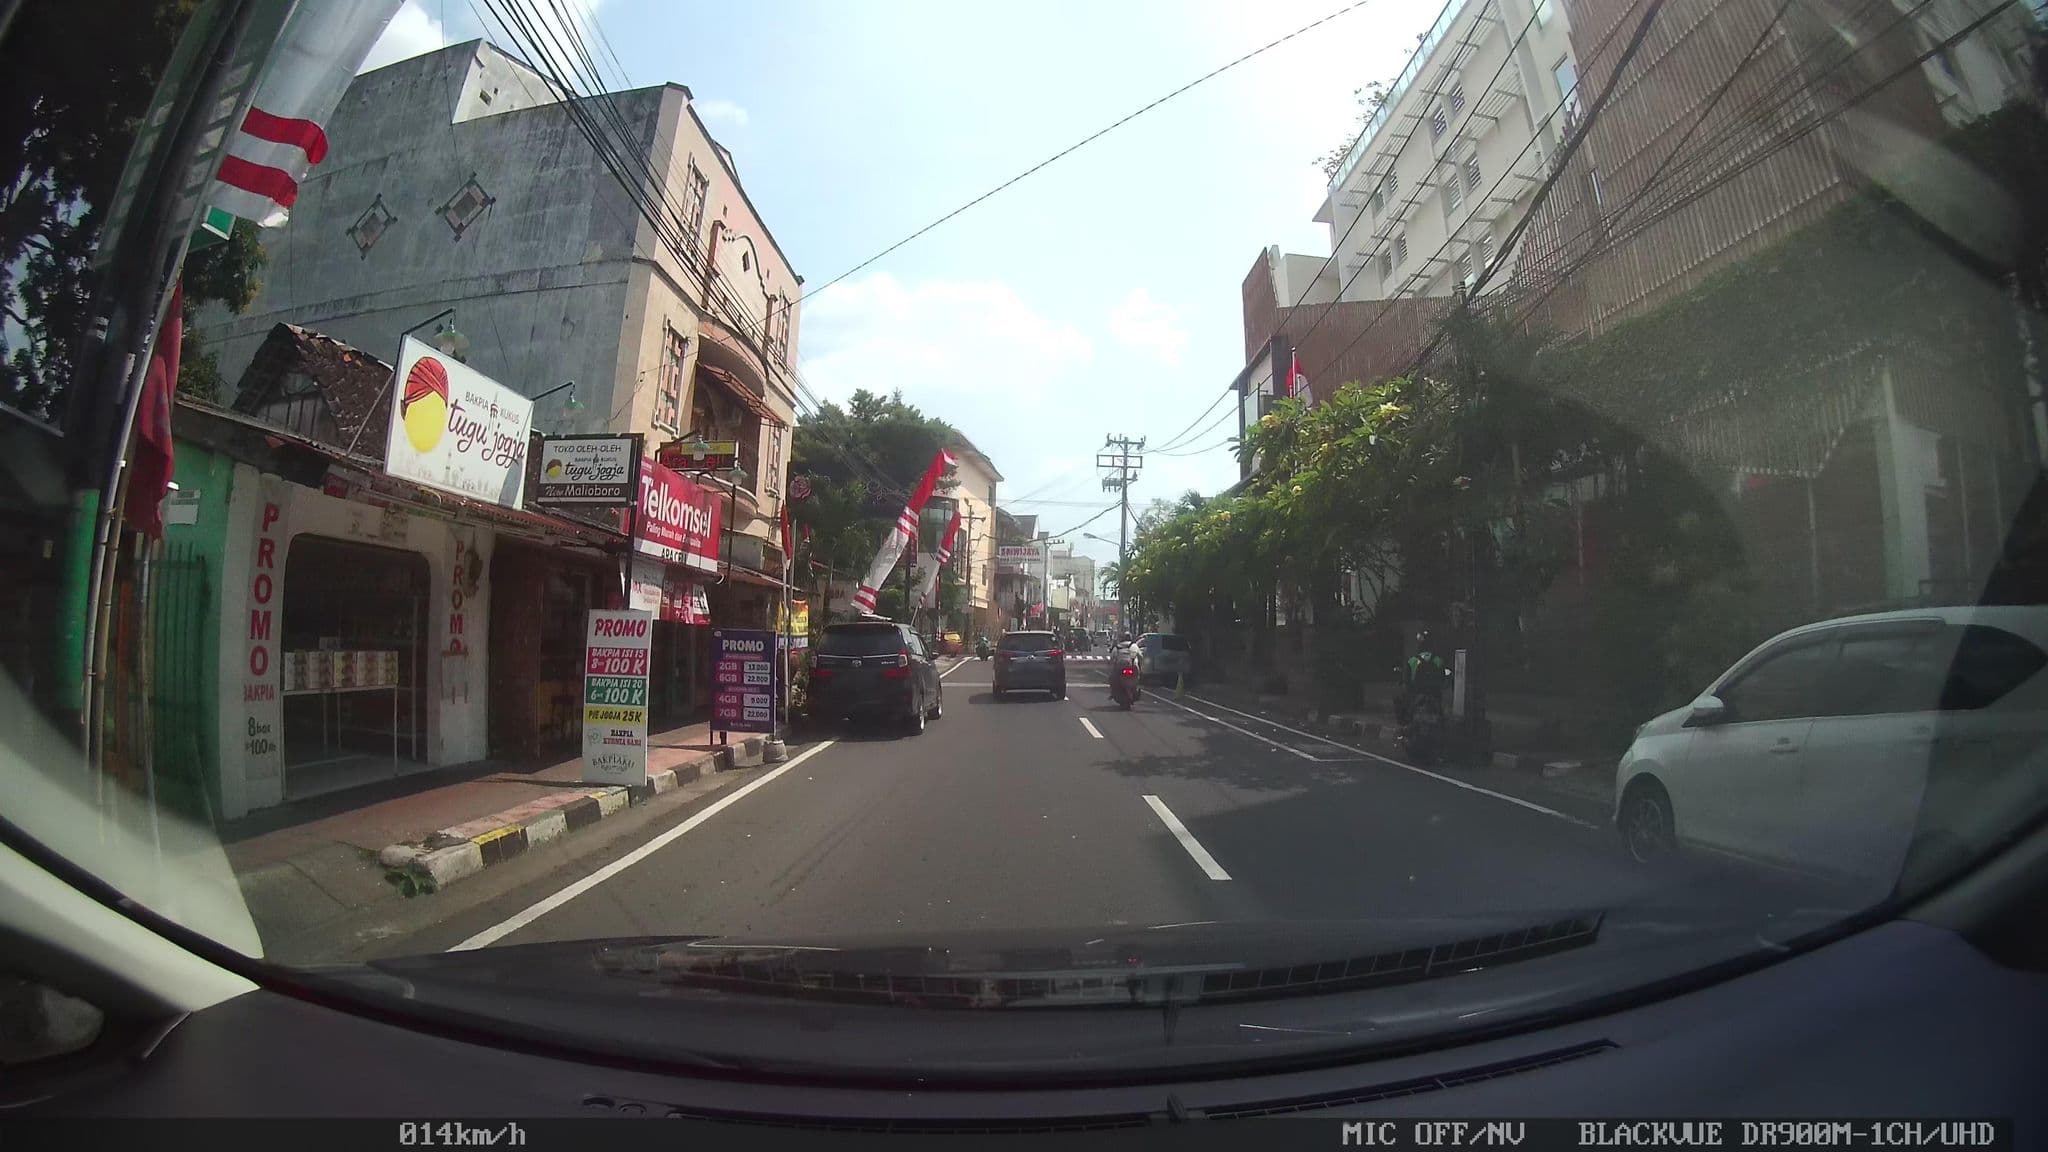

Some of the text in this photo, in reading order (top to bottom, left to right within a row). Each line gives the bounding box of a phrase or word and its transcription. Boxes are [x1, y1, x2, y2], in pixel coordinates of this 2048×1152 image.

[465, 391, 519, 425] BAKPIA KUKUS
[448, 399, 525, 468] tugu jogja
[554, 445, 575, 453] TOKO
[565, 462, 593, 481] tugu
[589, 463, 624, 481] jogja
[564, 485, 620, 496] Malioboro
[642, 475, 712, 538] Telkomsel
[250, 502, 280, 677] PROMO
[594, 618, 647, 638] PROMO
[592, 648, 644, 658] BAKPIA ISI 15
[722, 640, 764, 652] PROMO
[604, 658, 630, 674] 100
[633, 659, 645, 674] K
[719, 663, 737, 671] 2GB
[591, 678, 643, 689] BAKPIA ISI 20
[590, 688, 643, 705] 6 100 K
[588, 710, 600, 719] PIE
[622, 711, 642, 722] 25K
